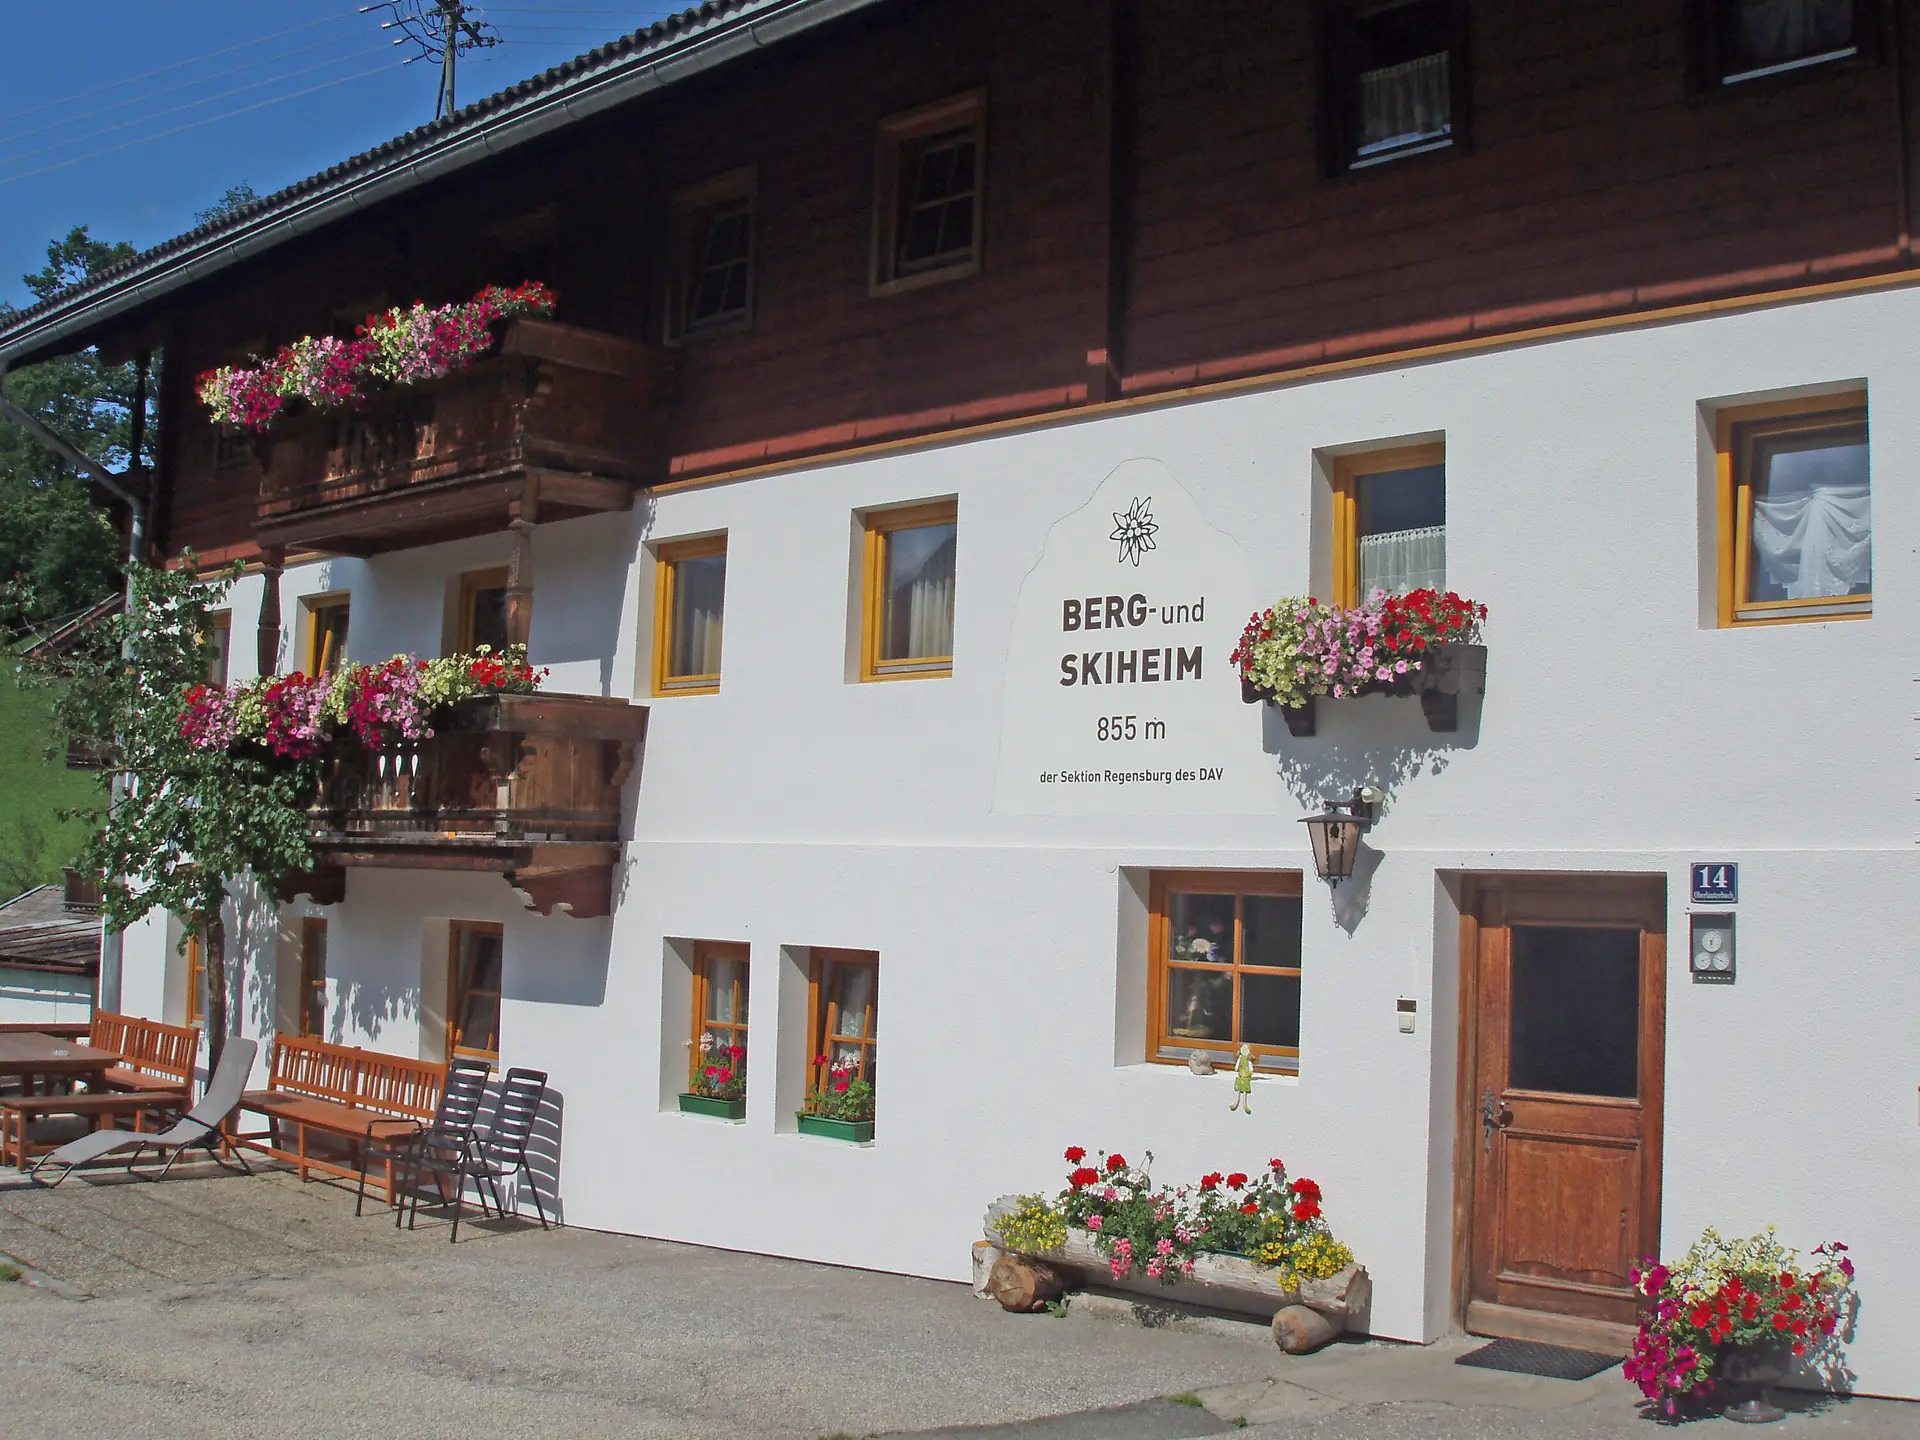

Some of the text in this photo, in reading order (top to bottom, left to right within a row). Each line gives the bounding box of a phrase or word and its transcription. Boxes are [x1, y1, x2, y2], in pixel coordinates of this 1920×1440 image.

[1059, 645, 1203, 687] SKIHEIM
[1097, 715, 1166, 742] 855 m
[1039, 767, 1224, 785] der Sektion Regensburg des DAV
[1699, 866, 1728, 888] 14
